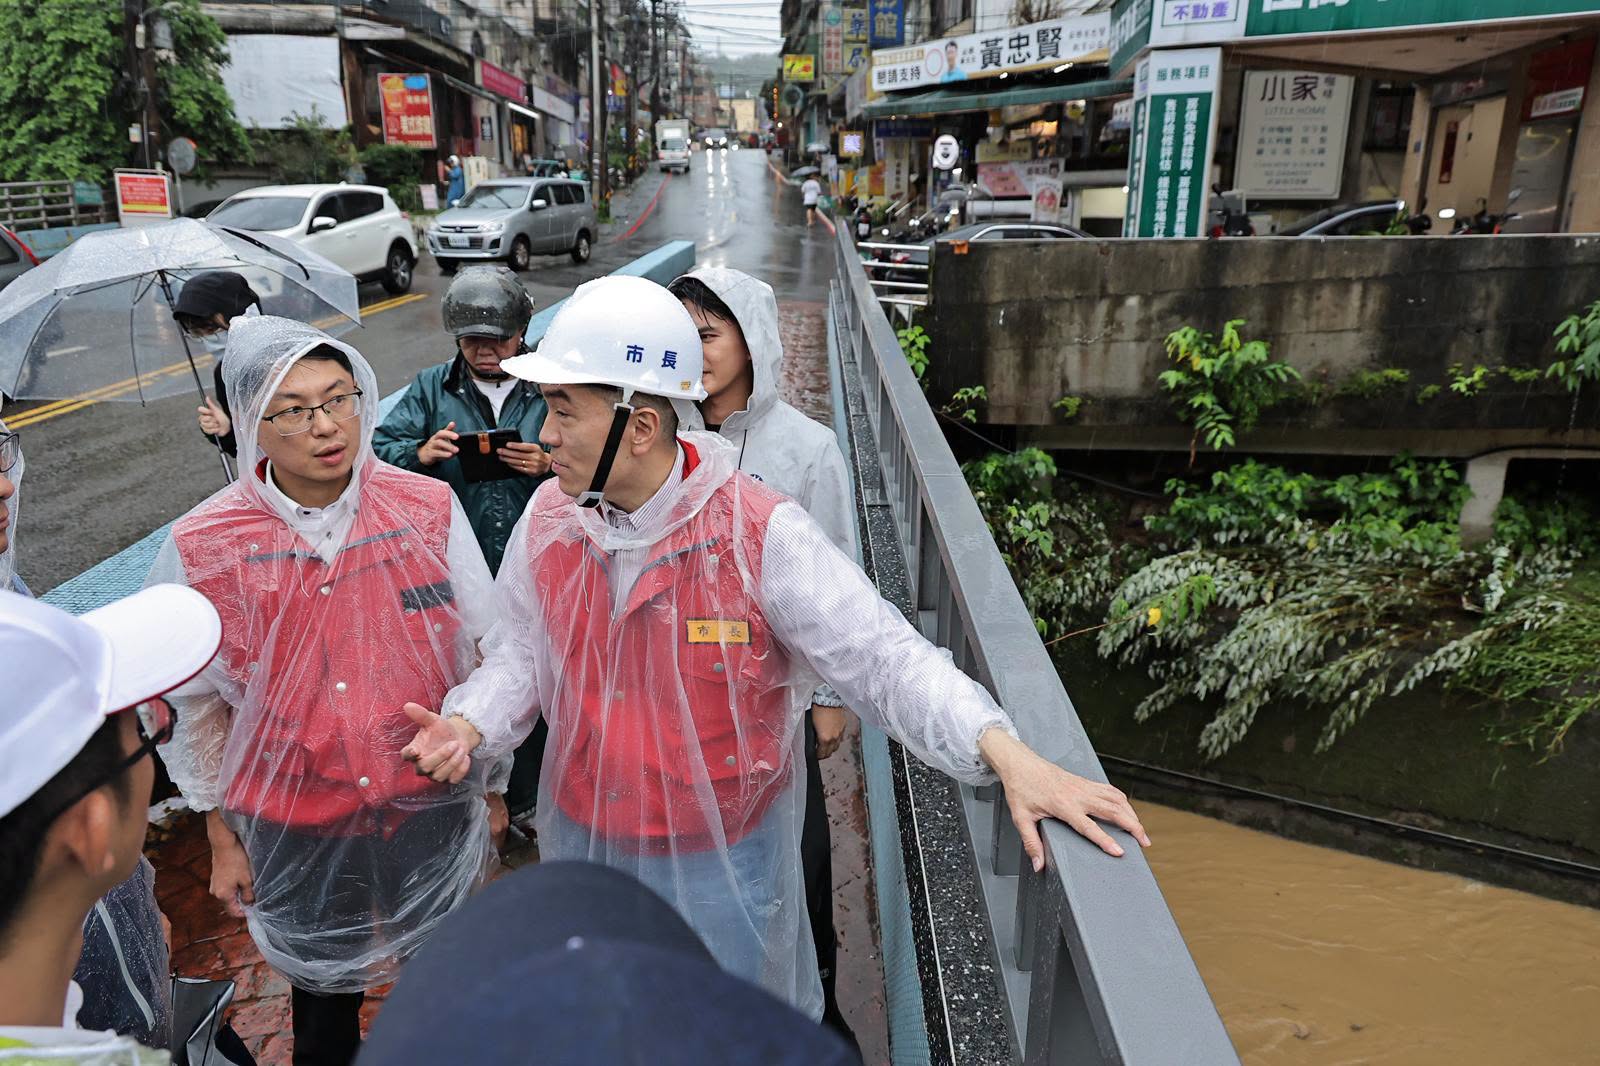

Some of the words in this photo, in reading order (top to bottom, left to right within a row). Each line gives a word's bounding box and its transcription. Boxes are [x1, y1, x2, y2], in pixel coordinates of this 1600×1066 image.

[1173, 1, 1230, 20] 不動產
[980, 27, 1062, 70] 黃忠賢
[1156, 64, 1210, 82] 服務項目
[1260, 75, 1319, 102] 小家
[626, 345, 677, 370] 市長
[697, 624, 741, 638] 市長
